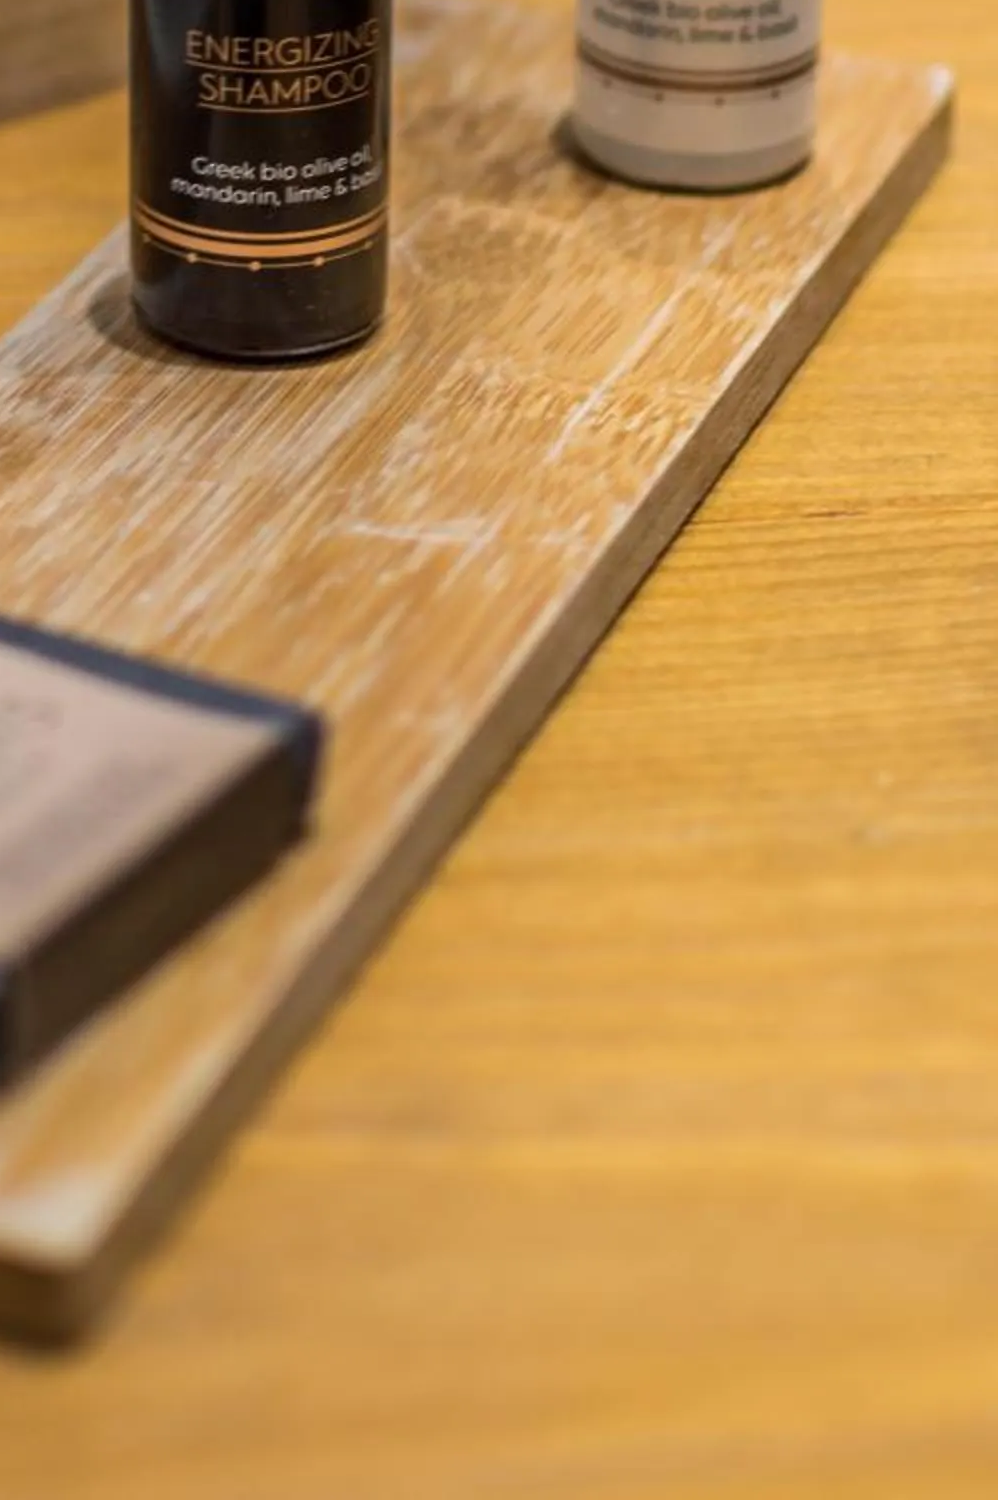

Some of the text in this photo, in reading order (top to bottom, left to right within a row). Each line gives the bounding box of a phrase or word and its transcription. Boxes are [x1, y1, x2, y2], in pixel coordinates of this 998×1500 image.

[186, 17, 381, 66] ENERGIZING
[198, 62, 371, 106] SHAMPOO
[190, 156, 256, 181] Greek
[259, 162, 298, 182] bio
[301, 156, 348, 179] olive
[170, 177, 282, 207] mandarin,
[284, 184, 333, 204] lime
[333, 177, 349, 197] &
